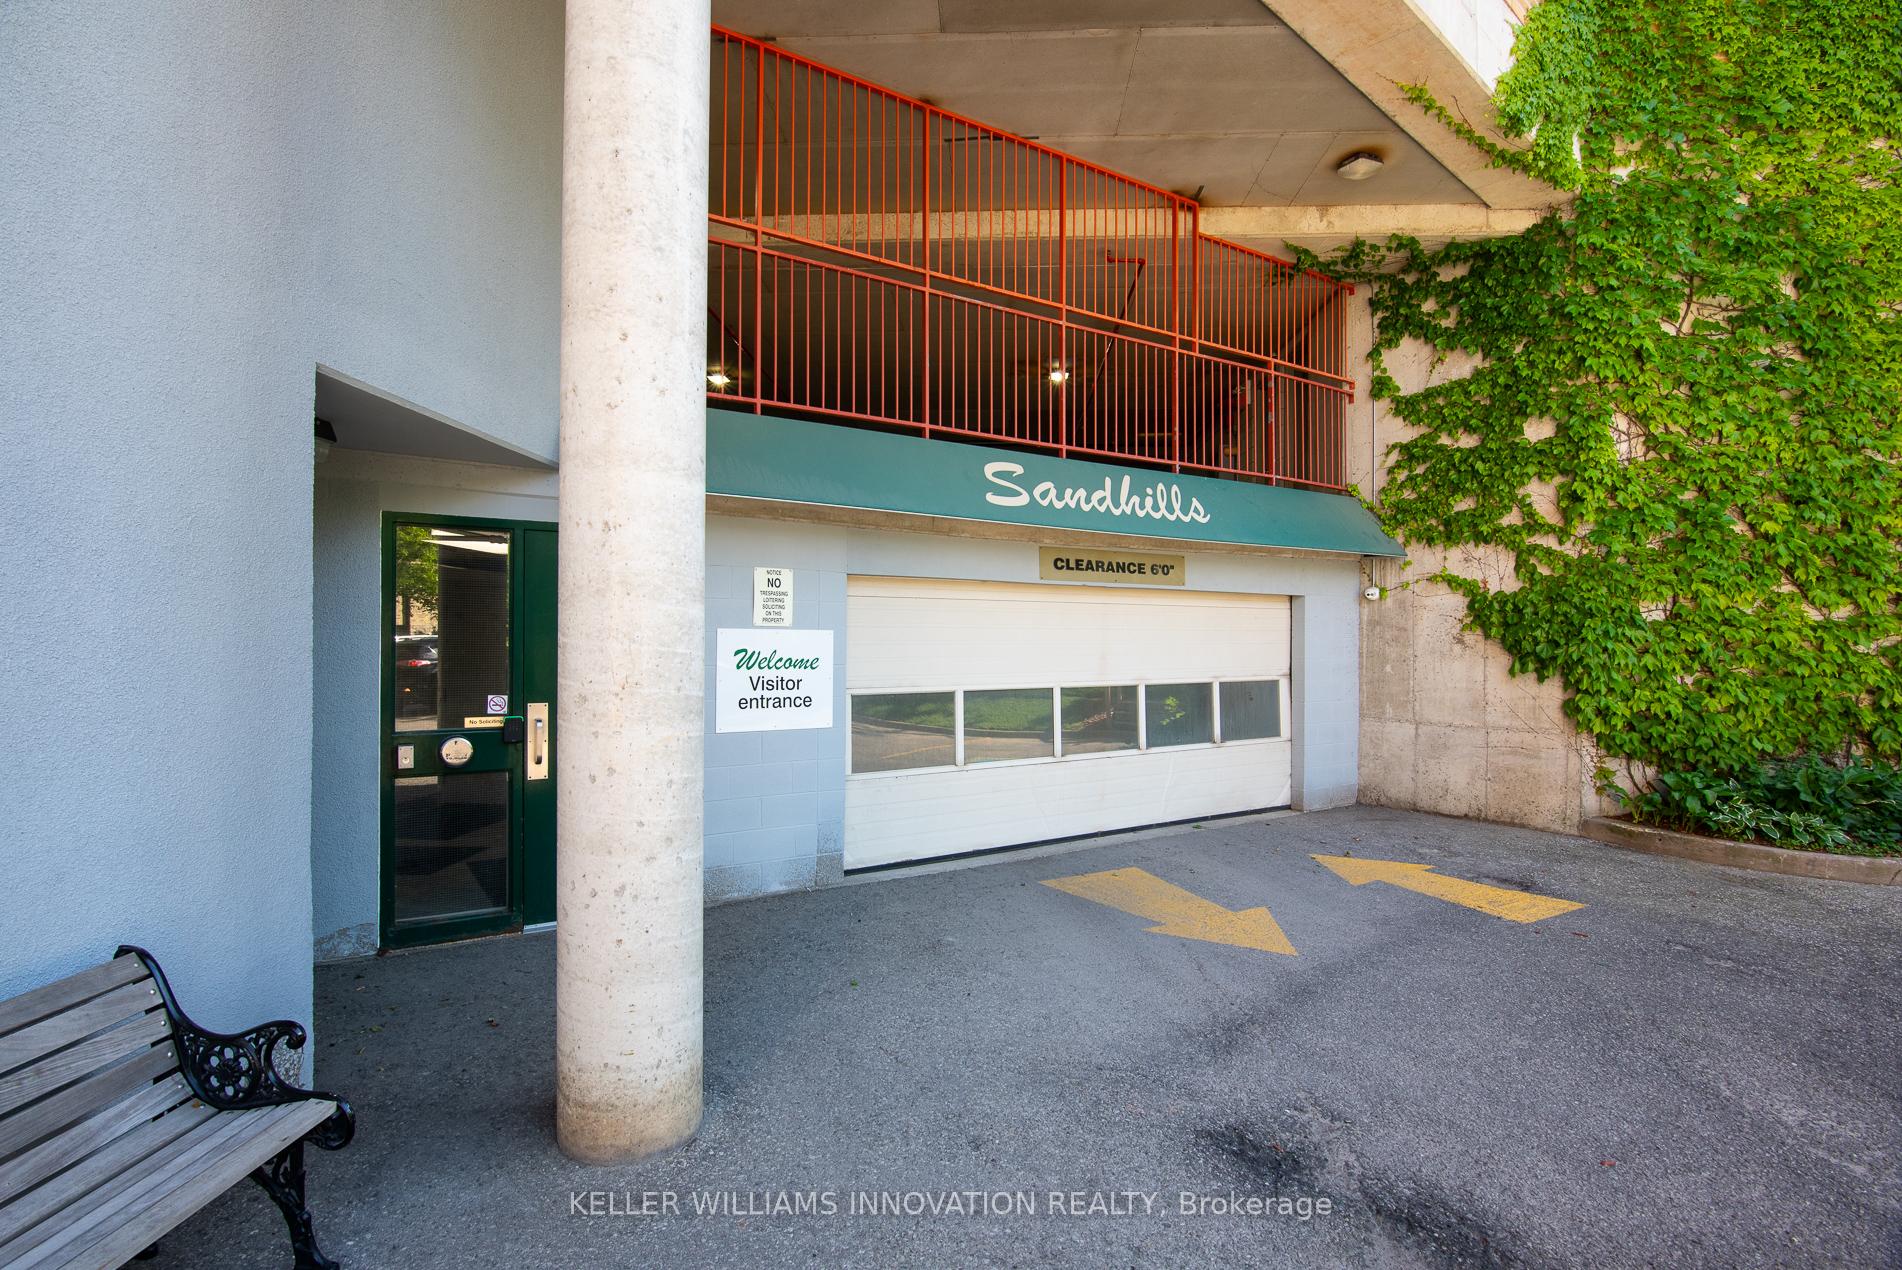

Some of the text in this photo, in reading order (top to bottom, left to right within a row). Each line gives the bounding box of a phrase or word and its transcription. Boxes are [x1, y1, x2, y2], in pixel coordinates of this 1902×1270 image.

[983, 461, 1211, 524] Sandhills
[1053, 557, 1175, 576] CLEARANCE 6'0"
[767, 577, 781, 588] NO
[734, 648, 820, 671] Welcome
[749, 675, 803, 691] Visitor
[738, 694, 812, 710] entrance
